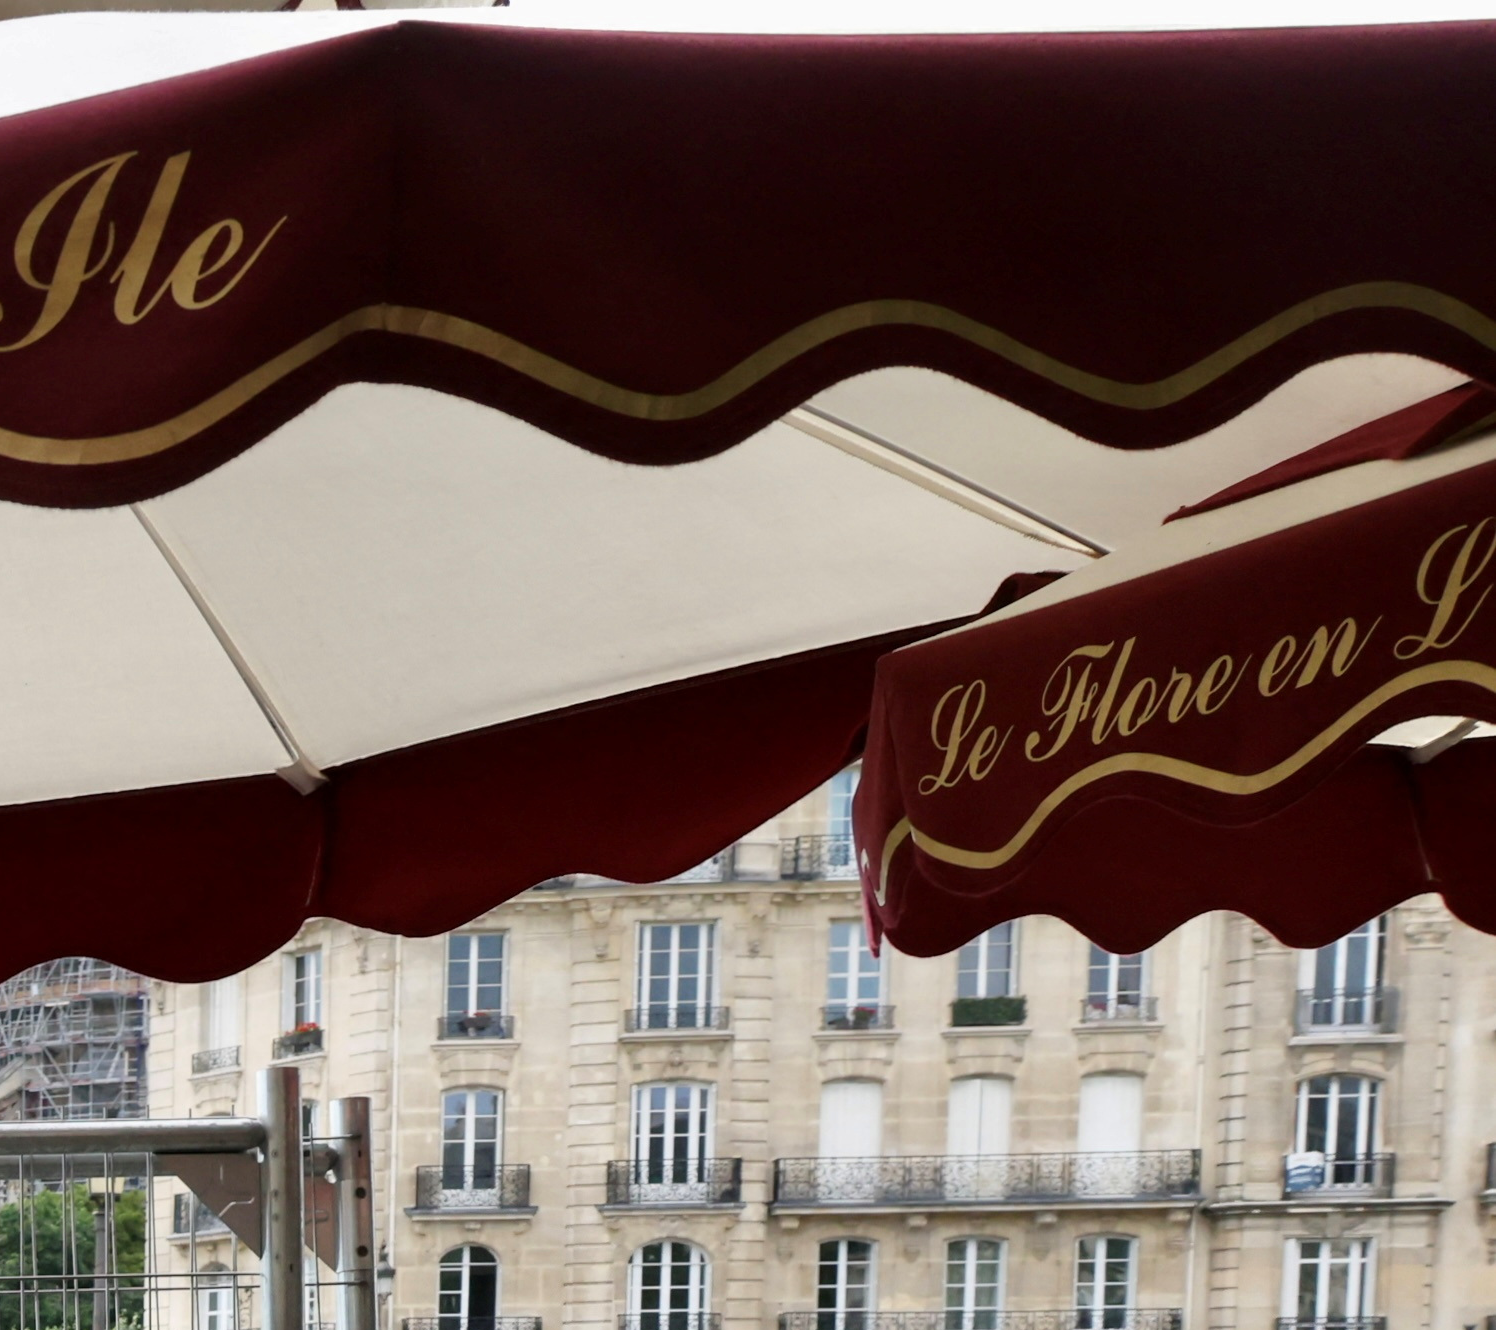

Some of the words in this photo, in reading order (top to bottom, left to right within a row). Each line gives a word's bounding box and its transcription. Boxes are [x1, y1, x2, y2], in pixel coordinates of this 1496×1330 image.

[918, 679, 1014, 796] Le
[1024, 636, 1253, 763] Flore
[1257, 615, 1383, 698] en
